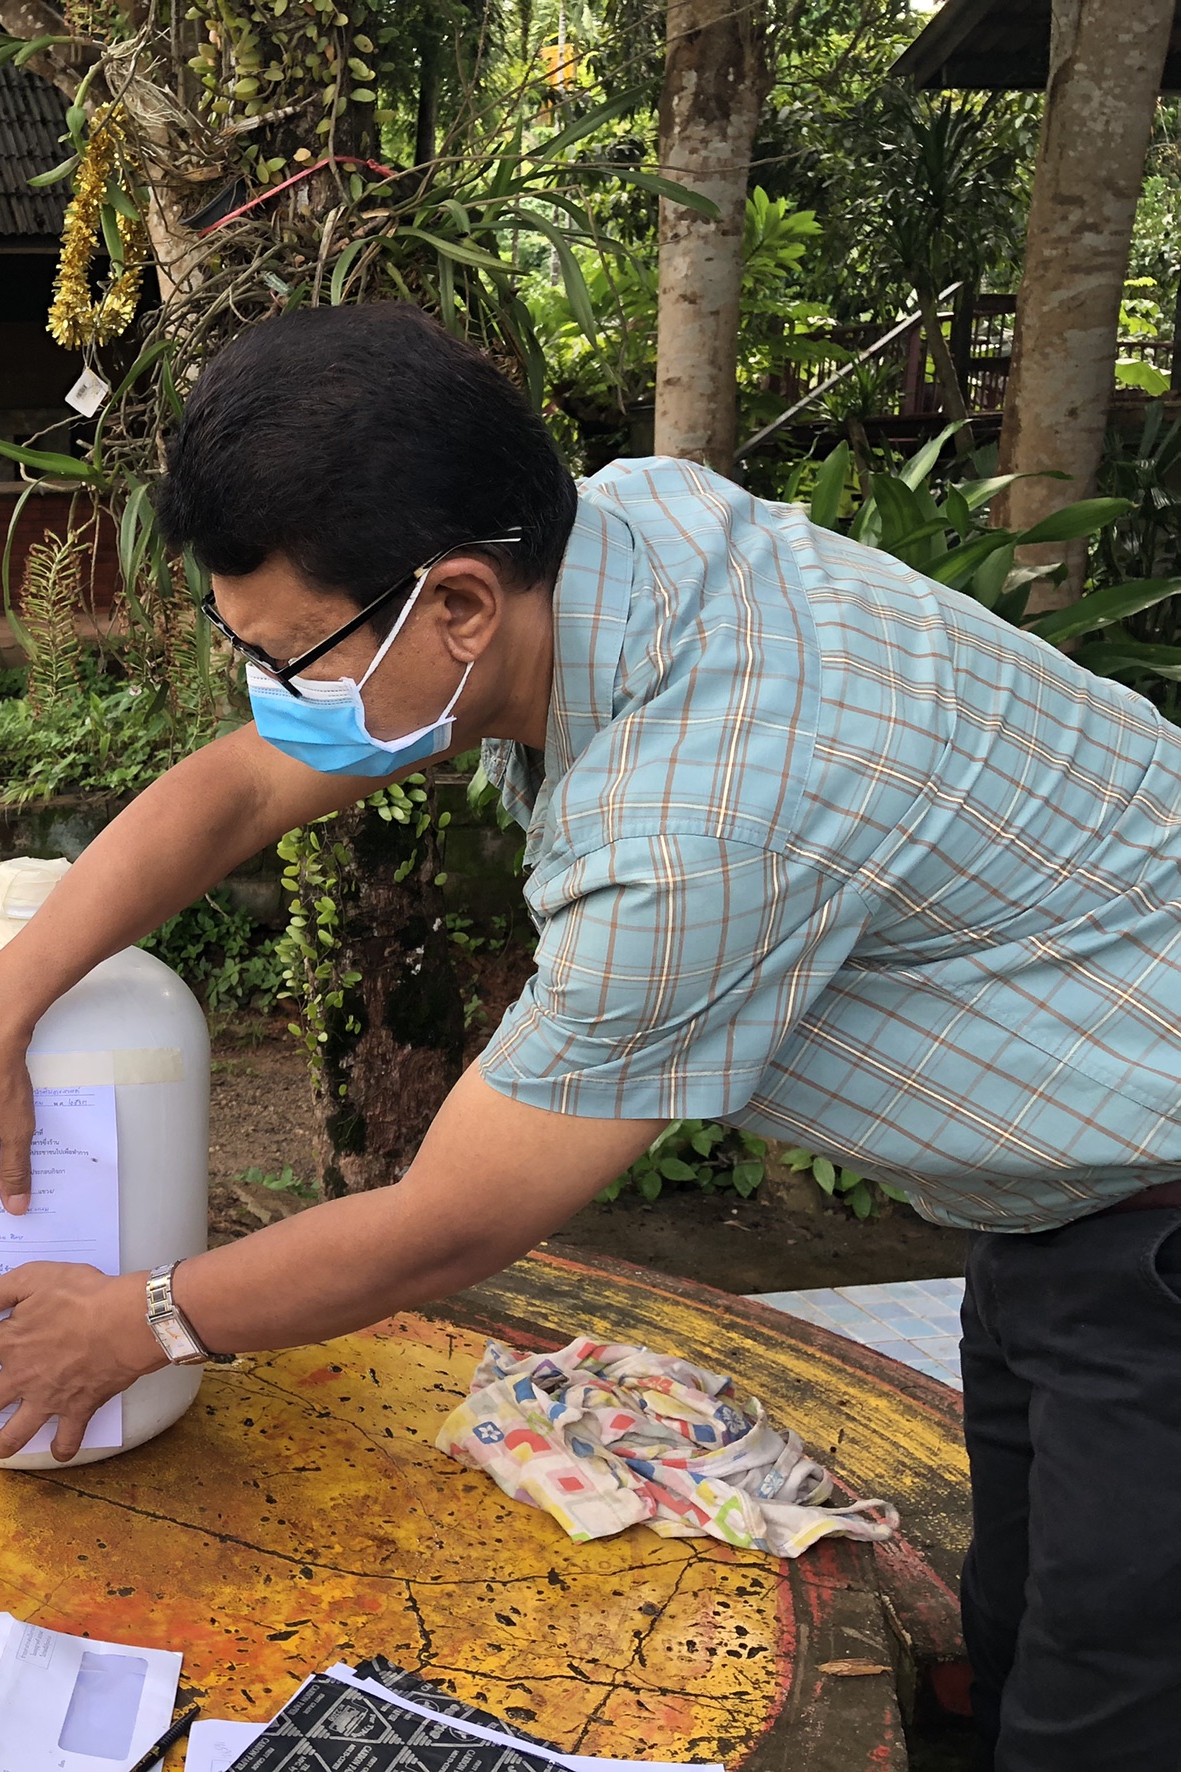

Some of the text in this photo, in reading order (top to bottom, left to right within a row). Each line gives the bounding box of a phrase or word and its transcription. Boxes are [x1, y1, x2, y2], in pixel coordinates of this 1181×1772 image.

[235, 1736, 270, 1772] CARBON PAPER
[351, 1744, 372, 1767] CARBON
